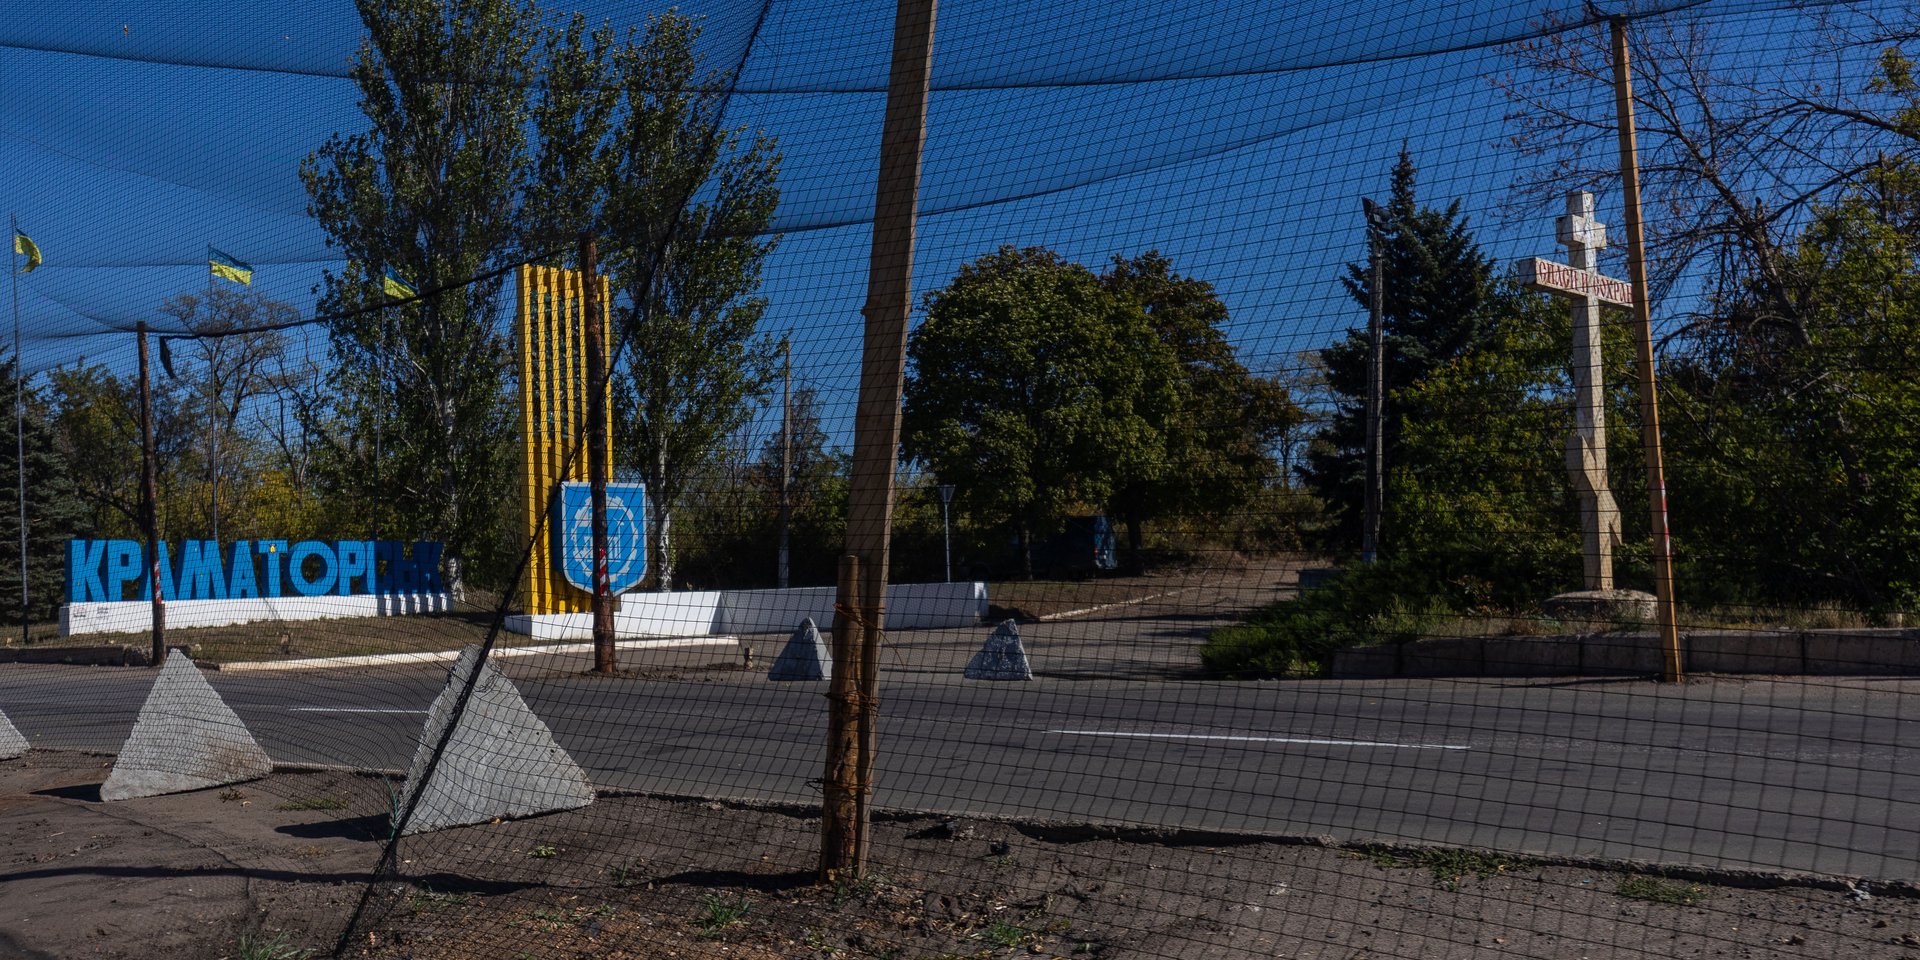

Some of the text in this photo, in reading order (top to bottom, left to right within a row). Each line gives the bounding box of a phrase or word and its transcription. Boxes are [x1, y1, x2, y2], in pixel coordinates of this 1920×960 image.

[1539, 261, 1579, 292] СПАСИ
[1593, 276, 1633, 303] СОХРАН
[69, 539, 444, 602] КРАМАТОРСЬК
